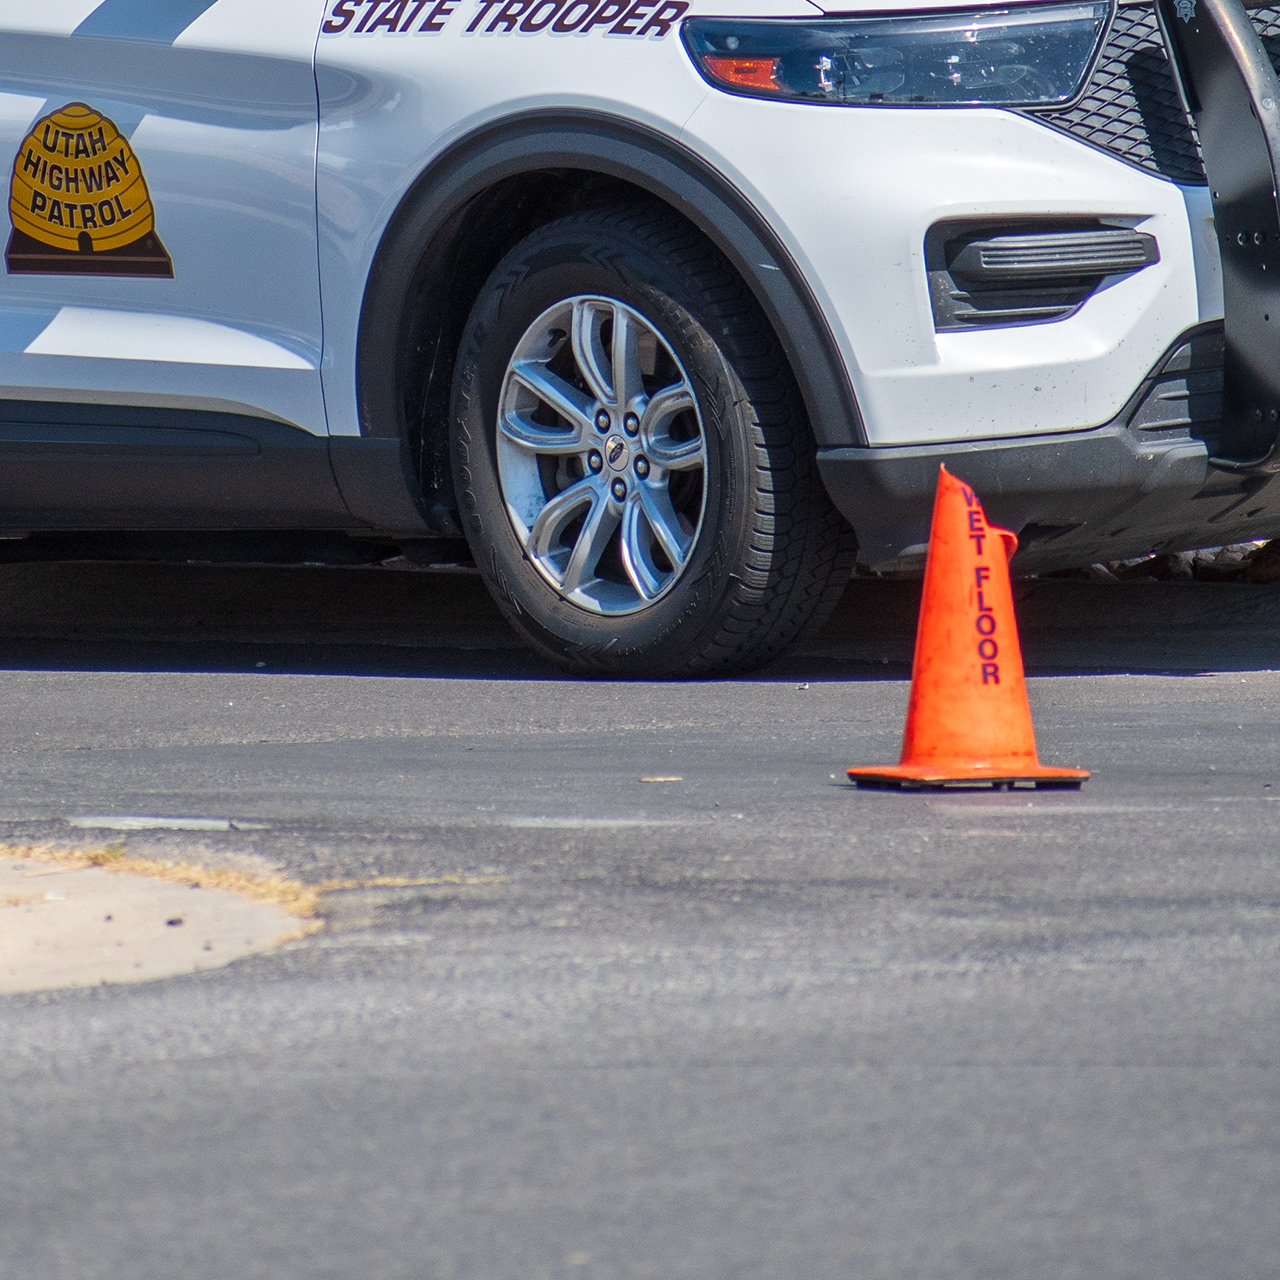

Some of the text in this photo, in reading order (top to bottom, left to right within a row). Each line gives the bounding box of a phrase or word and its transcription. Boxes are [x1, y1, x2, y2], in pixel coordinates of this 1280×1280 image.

[42, 124, 107, 159] UTAH
[23, 147, 130, 195] HIGHWAY
[30, 189, 132, 229] PATROL
[975, 567, 1000, 685] FLOOR
